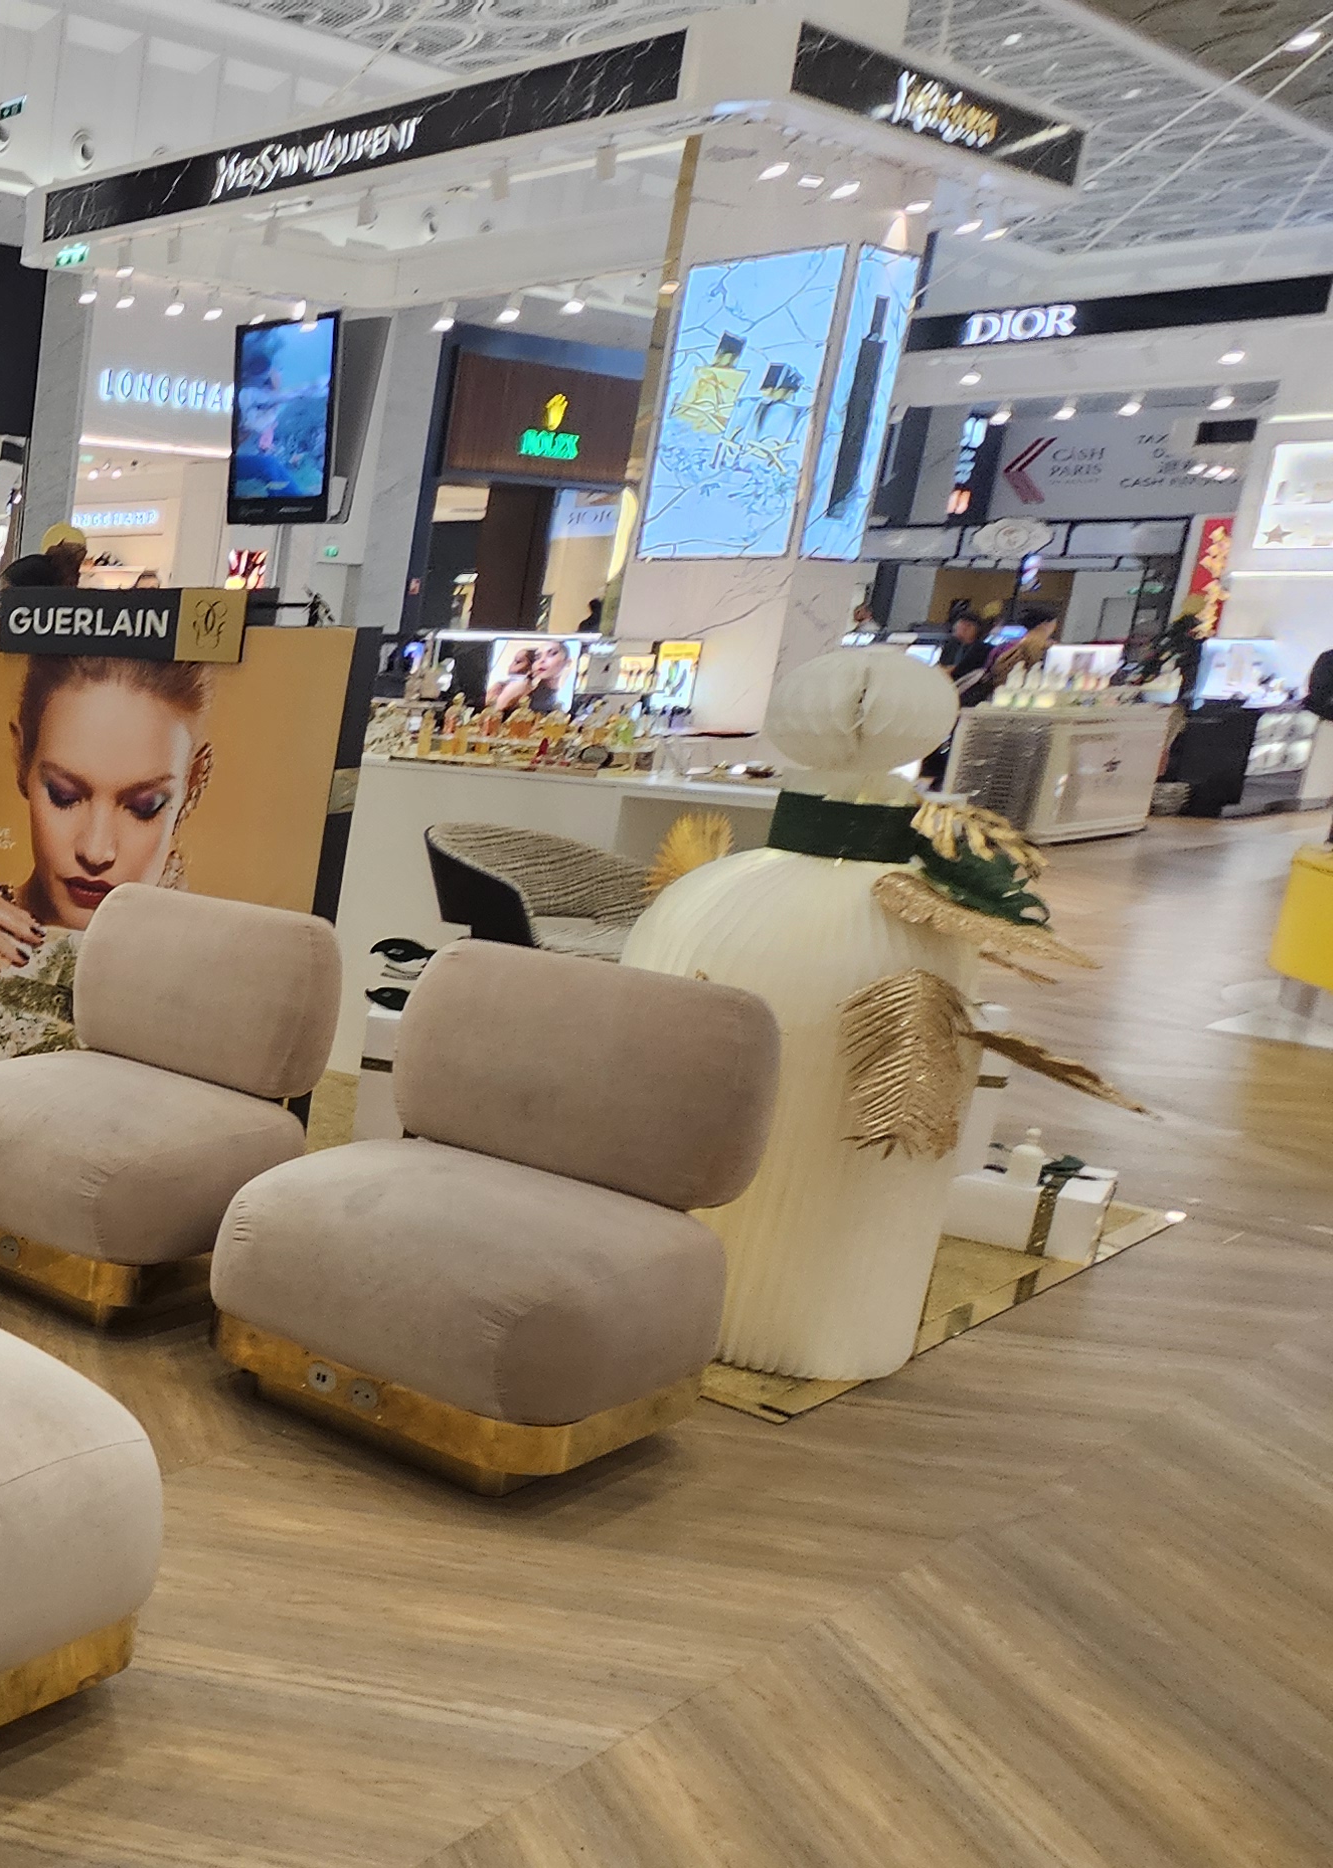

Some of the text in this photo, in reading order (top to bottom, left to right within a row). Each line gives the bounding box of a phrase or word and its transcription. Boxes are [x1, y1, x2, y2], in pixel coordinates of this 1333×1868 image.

[960, 304, 1077, 346] DIOR
[1053, 447, 1105, 462] CASH
[7, 606, 171, 639] GUERLAIN
